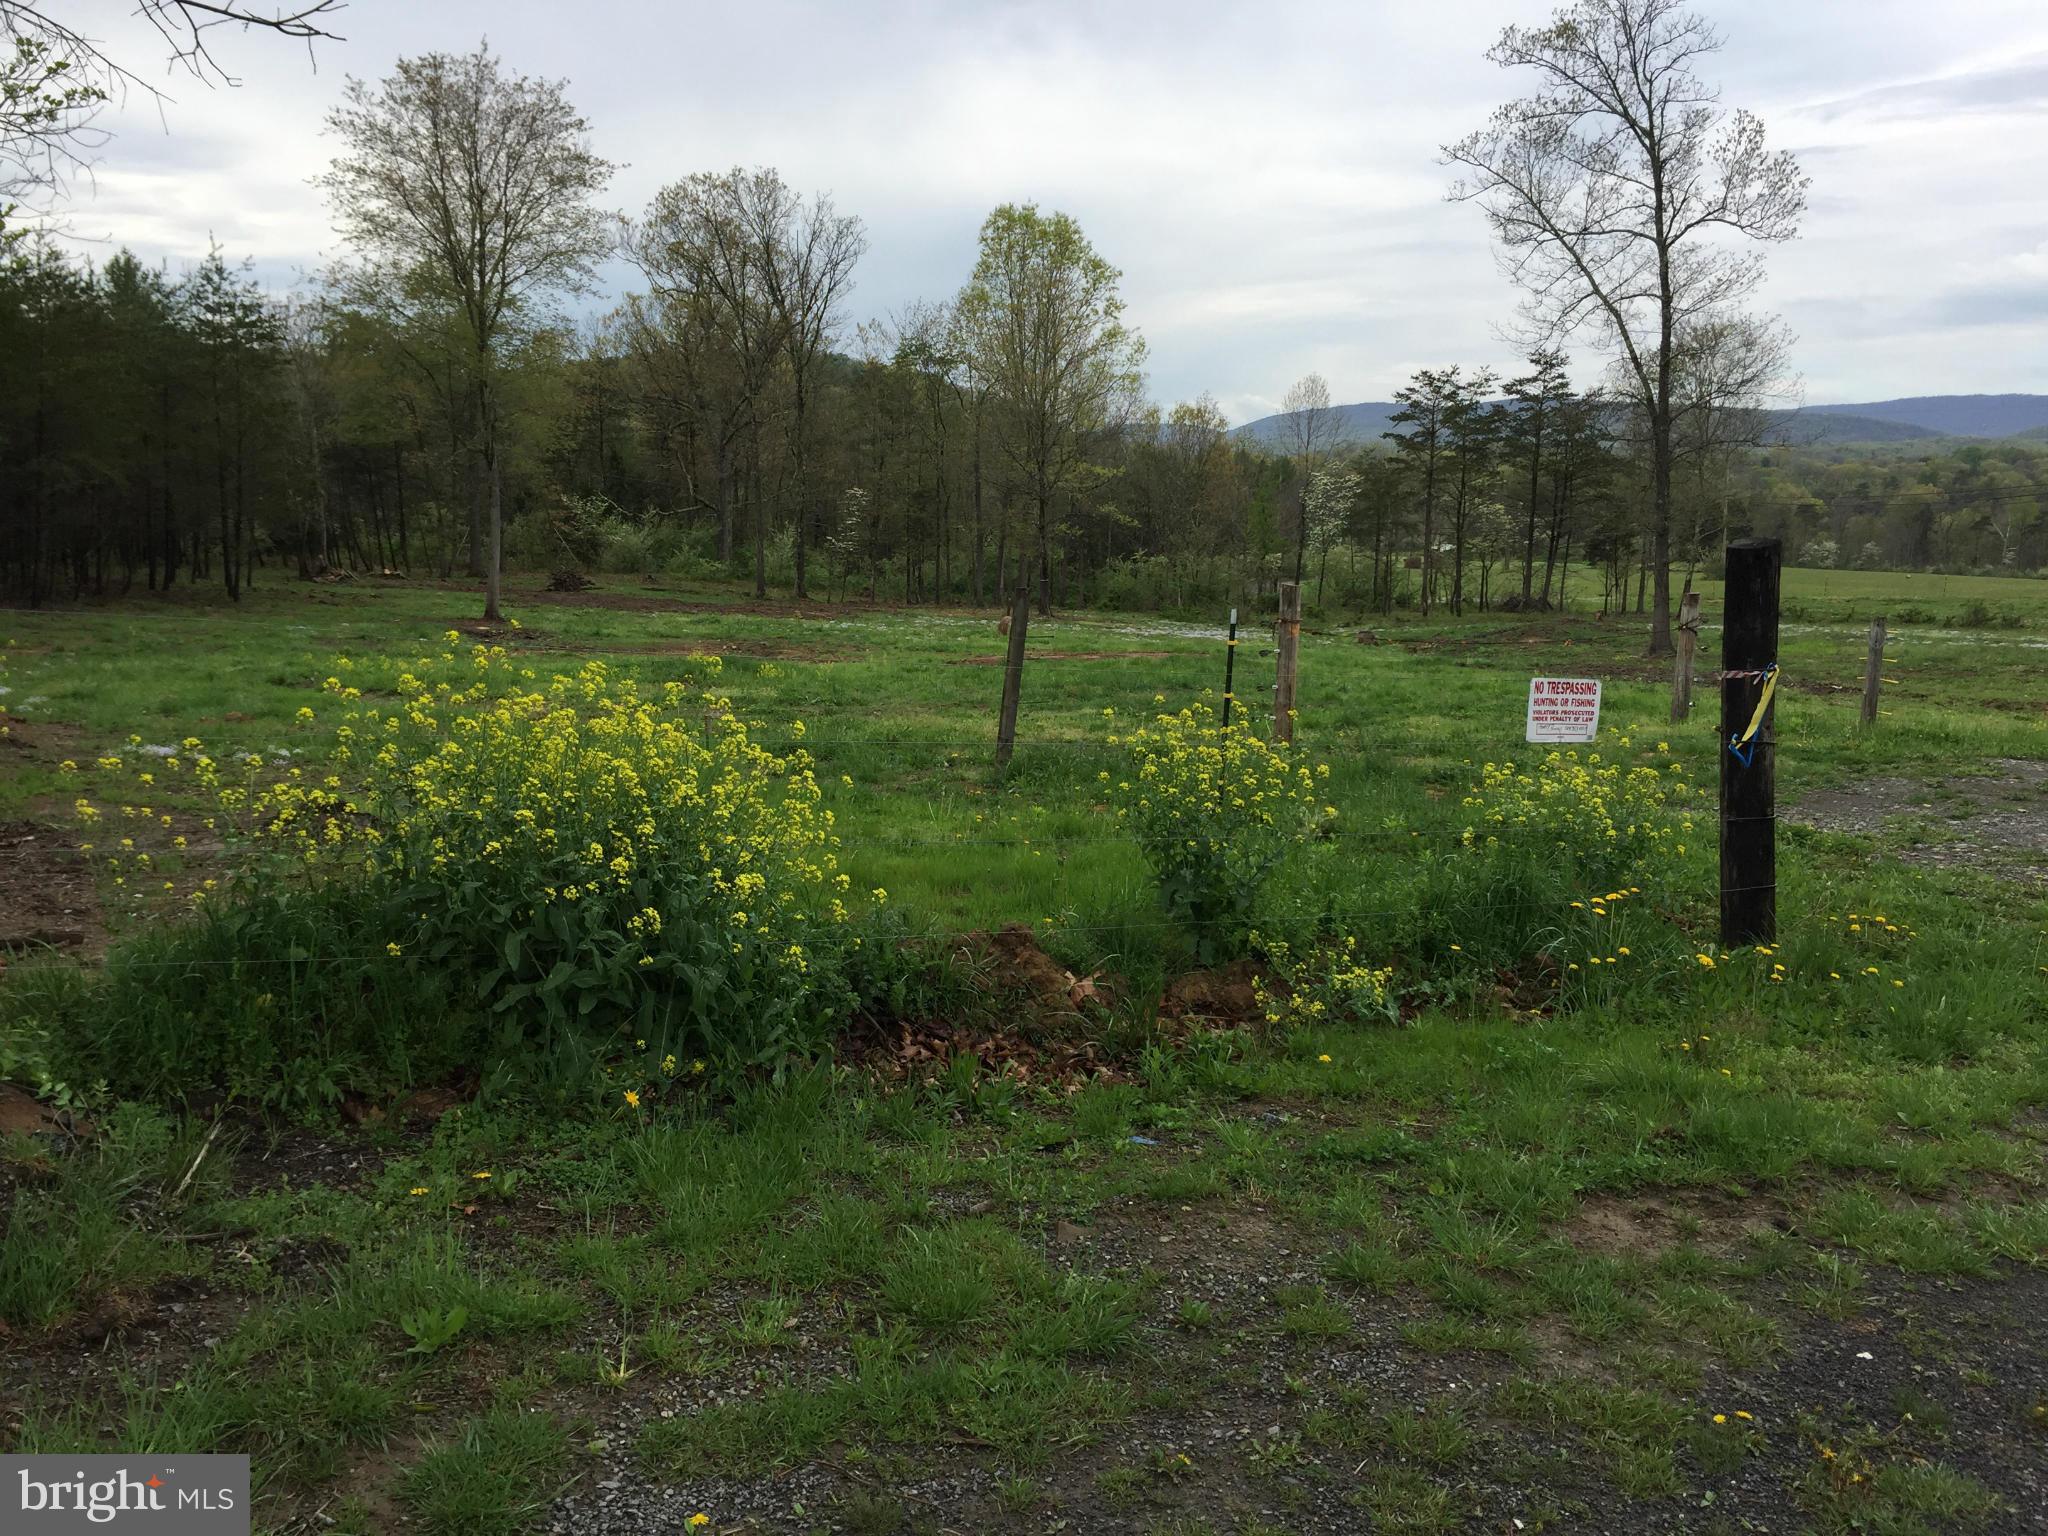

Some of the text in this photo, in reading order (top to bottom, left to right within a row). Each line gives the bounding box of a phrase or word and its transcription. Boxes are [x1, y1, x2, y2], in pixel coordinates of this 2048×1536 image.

[1534, 681, 1597, 695] NO TRESPASSING
[1533, 698, 1595, 707] HUNTING OR FISHING
